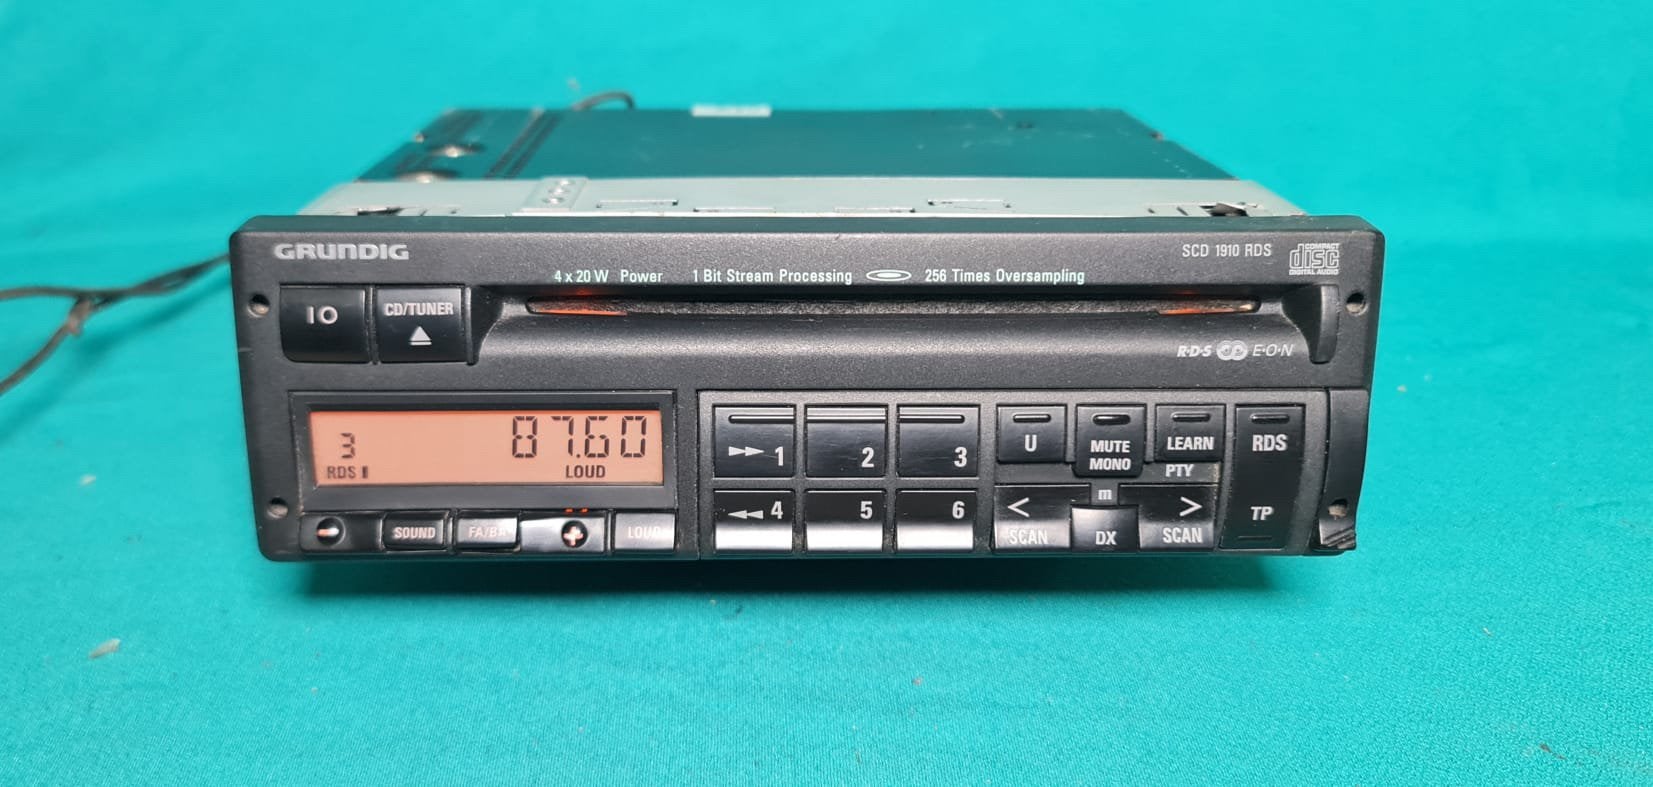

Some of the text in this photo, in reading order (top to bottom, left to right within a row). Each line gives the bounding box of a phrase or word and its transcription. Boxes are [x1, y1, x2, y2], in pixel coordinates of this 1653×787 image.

[273, 243, 410, 261] GRUNDIG
[1182, 244, 1272, 258] SCD 1910 RDS
[554, 270, 663, 284] 4 x 20 W Power
[692, 269, 852, 286] 1 Bit Stream Processing
[925, 269, 1085, 286] 256 Times Oversampling
[1288, 268, 1340, 276] DIGITAL AUDIO
[384, 301, 454, 317] CD/TUNER
[339, 415, 648, 459] 3 87.60
[1024, 435, 1037, 452] U
[1167, 436, 1214, 451] LEARN
[1252, 434, 1288, 452] RDS
[1090, 440, 1130, 454] MUTE
[774, 446, 784, 467] 1
[861, 447, 875, 468] 2
[953, 447, 968, 468] 3
[1089, 457, 1132, 472] MONO
[326, 465, 357, 480] RDS
[565, 465, 606, 479] LOUD
[1165, 463, 1194, 478] PTY
[770, 501, 784, 520] 4
[860, 501, 873, 520] 5
[952, 501, 965, 520] 6
[1251, 506, 1274, 521] TP
[394, 526, 436, 540] SOUND
[1008, 530, 1049, 545] SCAN
[1095, 531, 1117, 546] DX
[1162, 528, 1203, 544] SCAN
